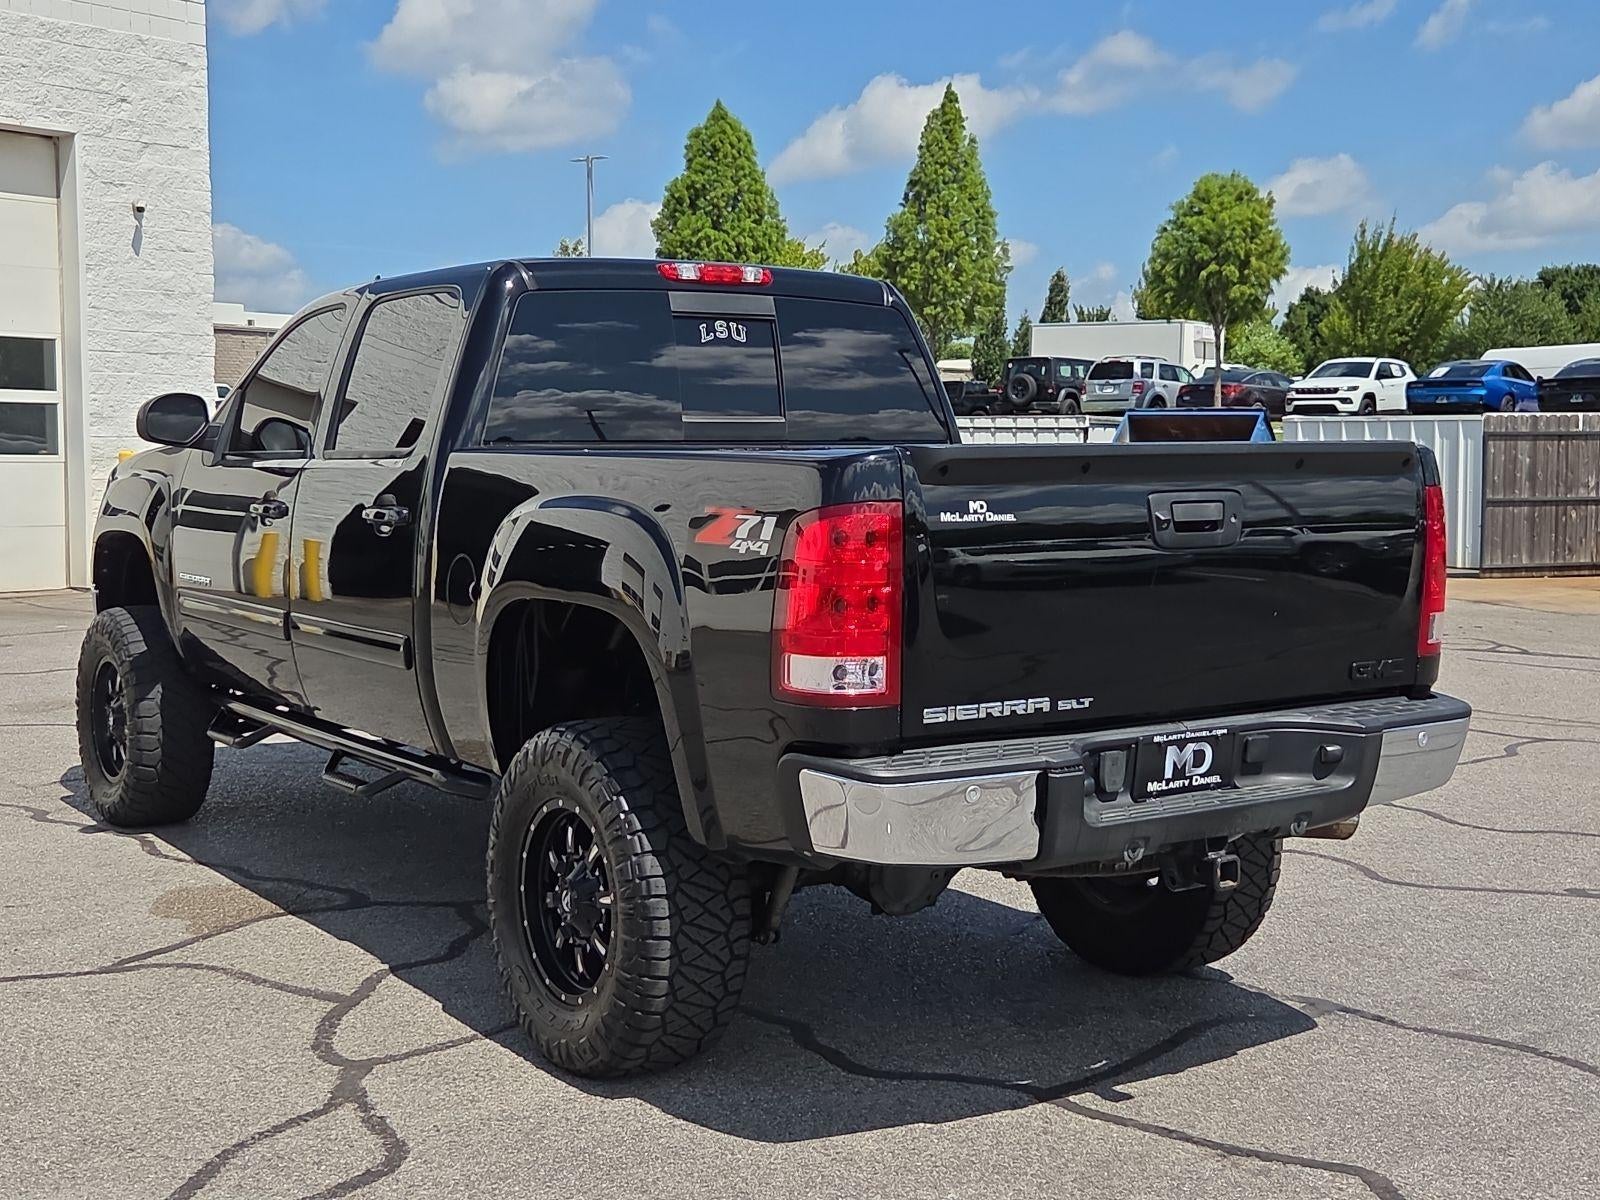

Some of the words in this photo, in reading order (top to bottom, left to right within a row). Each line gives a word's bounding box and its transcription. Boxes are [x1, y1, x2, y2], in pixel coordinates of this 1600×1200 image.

[699, 320, 747, 343] LSU
[968, 500, 988, 514] MD
[694, 506, 777, 545] Z71
[922, 696, 1051, 725] SIERRA
[1057, 697, 1094, 711] SLT
[1164, 742, 1212, 779] MD
